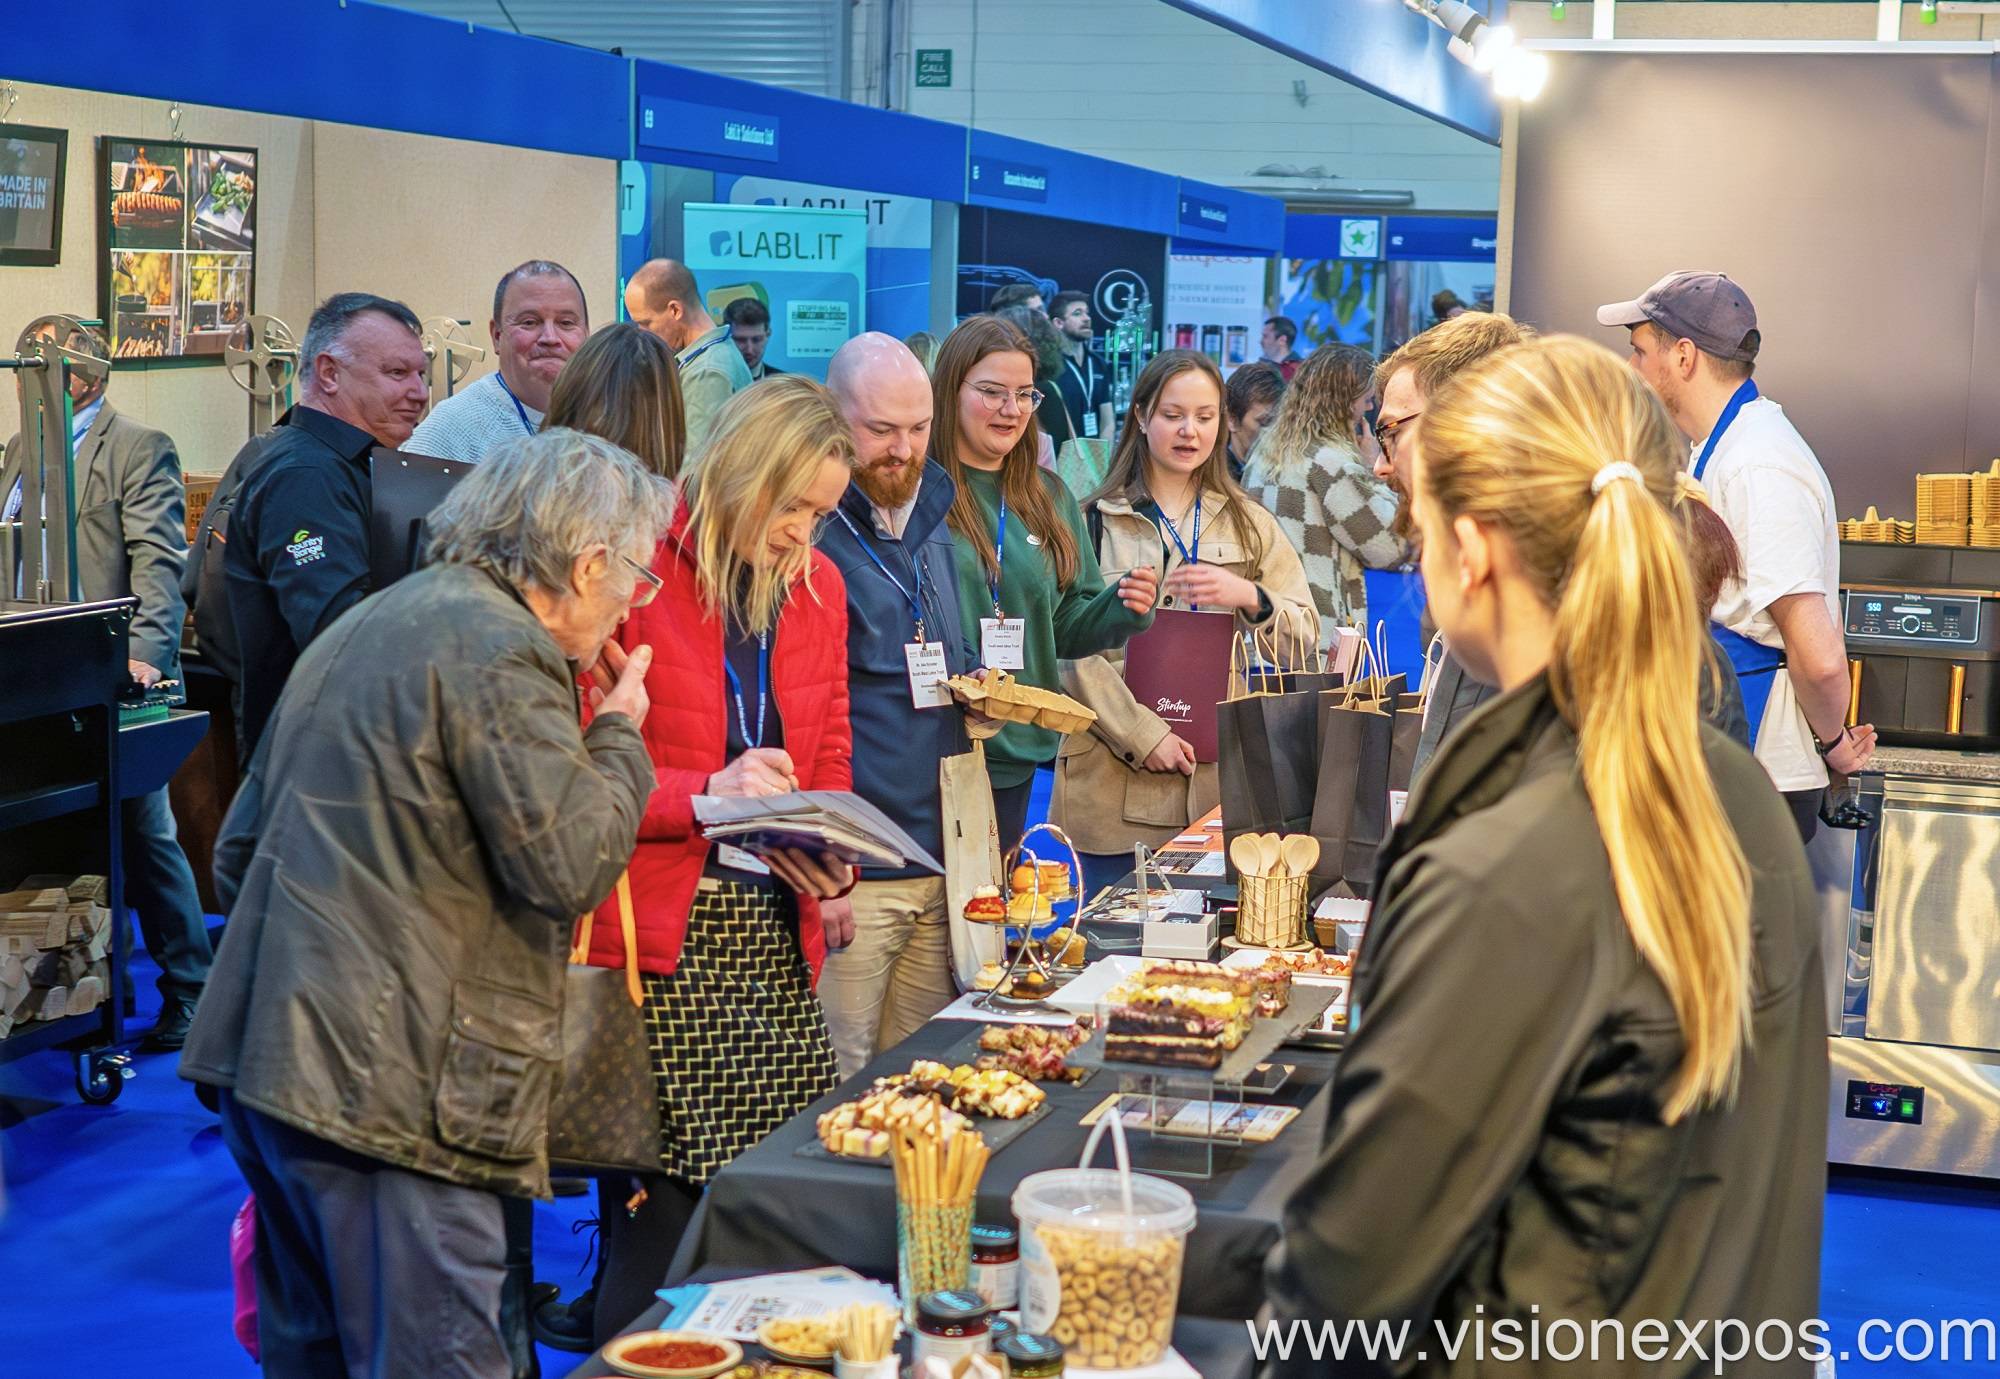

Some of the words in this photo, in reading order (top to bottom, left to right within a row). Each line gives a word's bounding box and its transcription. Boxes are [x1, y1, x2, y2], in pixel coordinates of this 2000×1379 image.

[0, 175, 31, 191] MADE
[33, 176, 47, 193] IN
[0, 192, 46, 210] BRITAIN
[738, 230, 843, 260] LABL.IT
[286, 536, 324, 553] Country
[293, 545, 323, 559] Range
